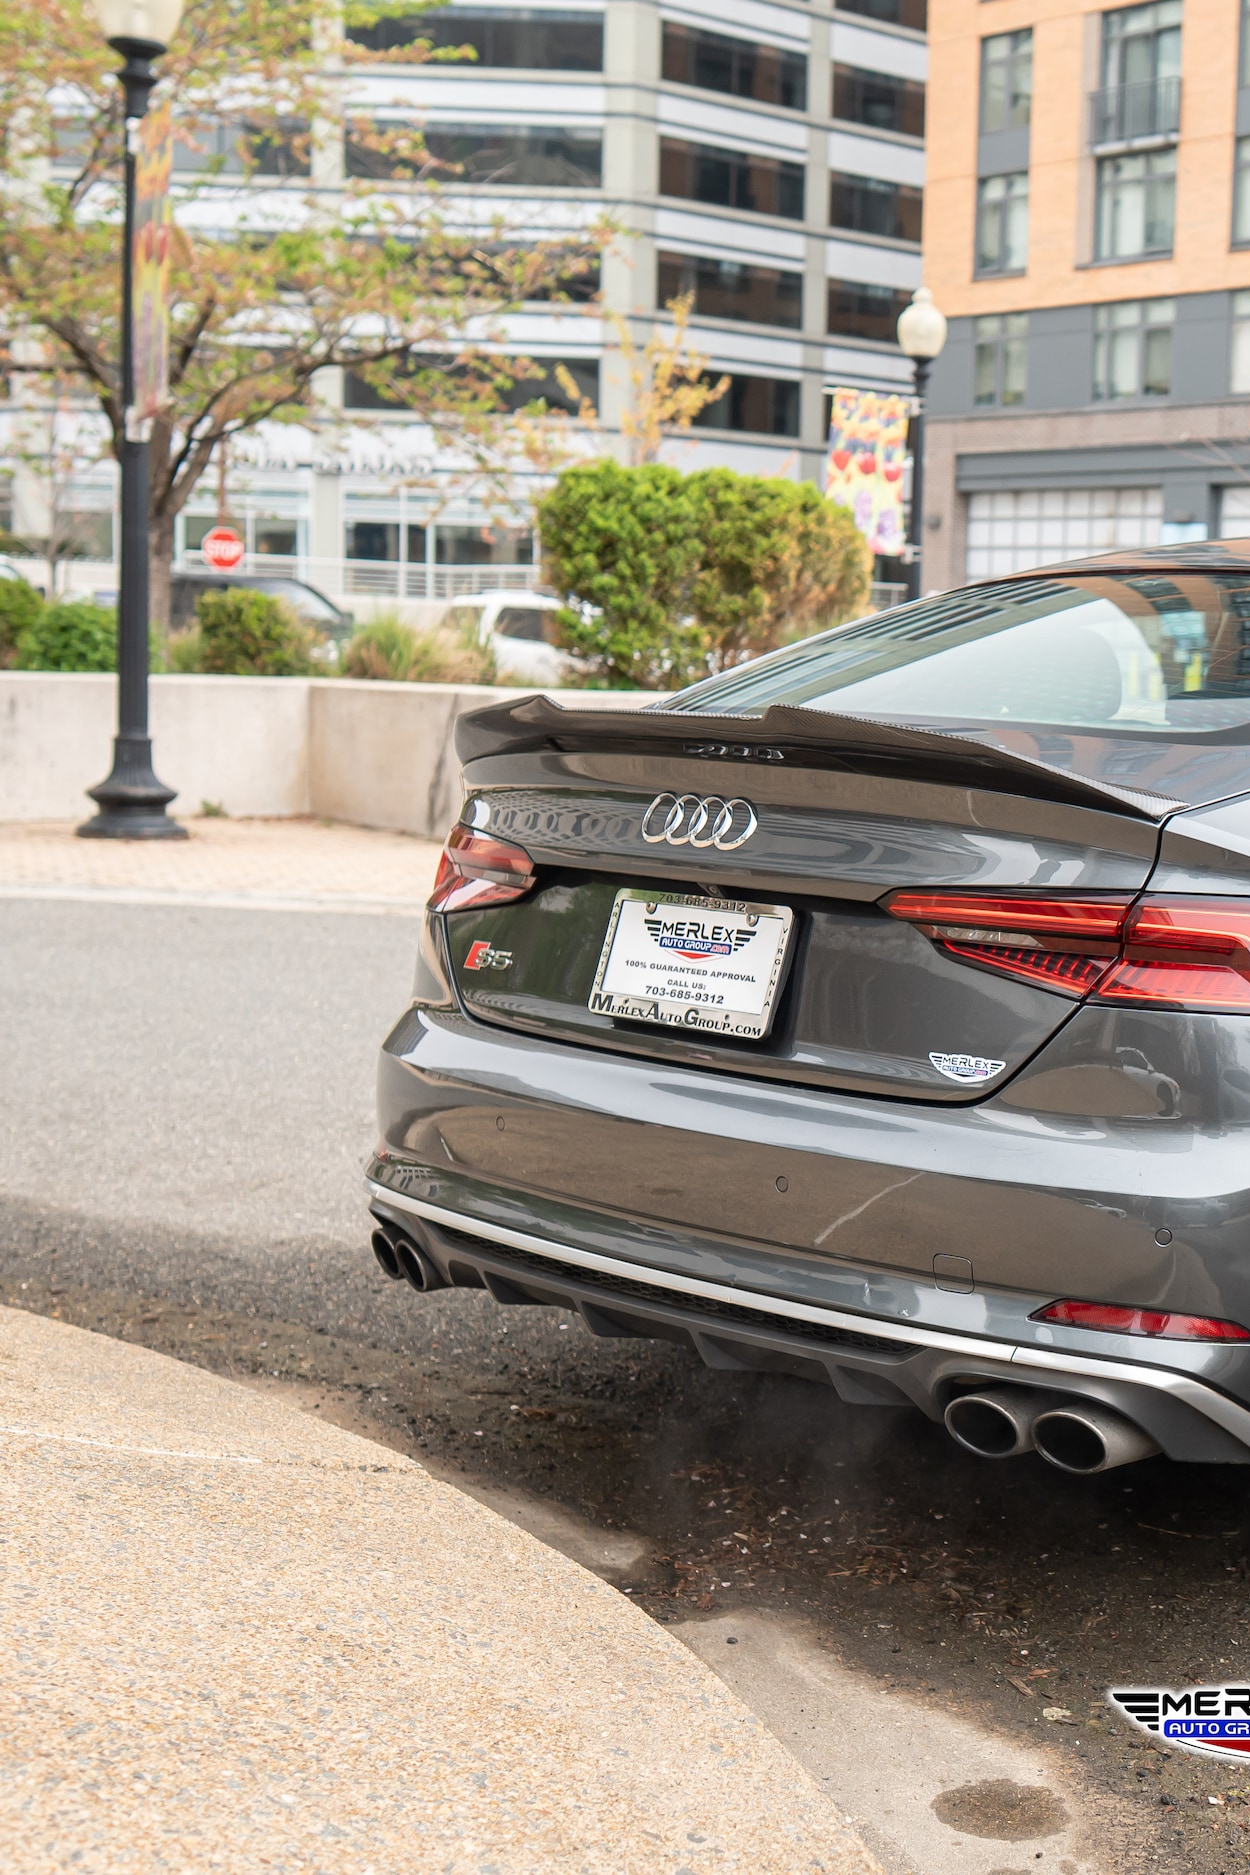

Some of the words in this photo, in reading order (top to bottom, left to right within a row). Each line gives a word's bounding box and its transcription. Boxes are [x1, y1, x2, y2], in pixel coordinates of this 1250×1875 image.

[204, 539, 243, 559] STOP
[660, 893, 746, 912] 703-685-9312
[661, 921, 734, 943] MERLEX
[595, 902, 620, 987] ARLINGTON
[661, 937, 683, 948] AUTO
[473, 947, 513, 970] S5
[764, 927, 788, 1007] VIRGINIA
[625, 959, 647, 969] 100%
[649, 962, 708, 976] GUARANTEED
[710, 970, 756, 983] APPROVAL
[667, 979, 689, 988] CALL
[691, 982, 707, 990] US:
[645, 985, 724, 1005] 703-685-9312
[942, 1056, 989, 1069] MERLEX
